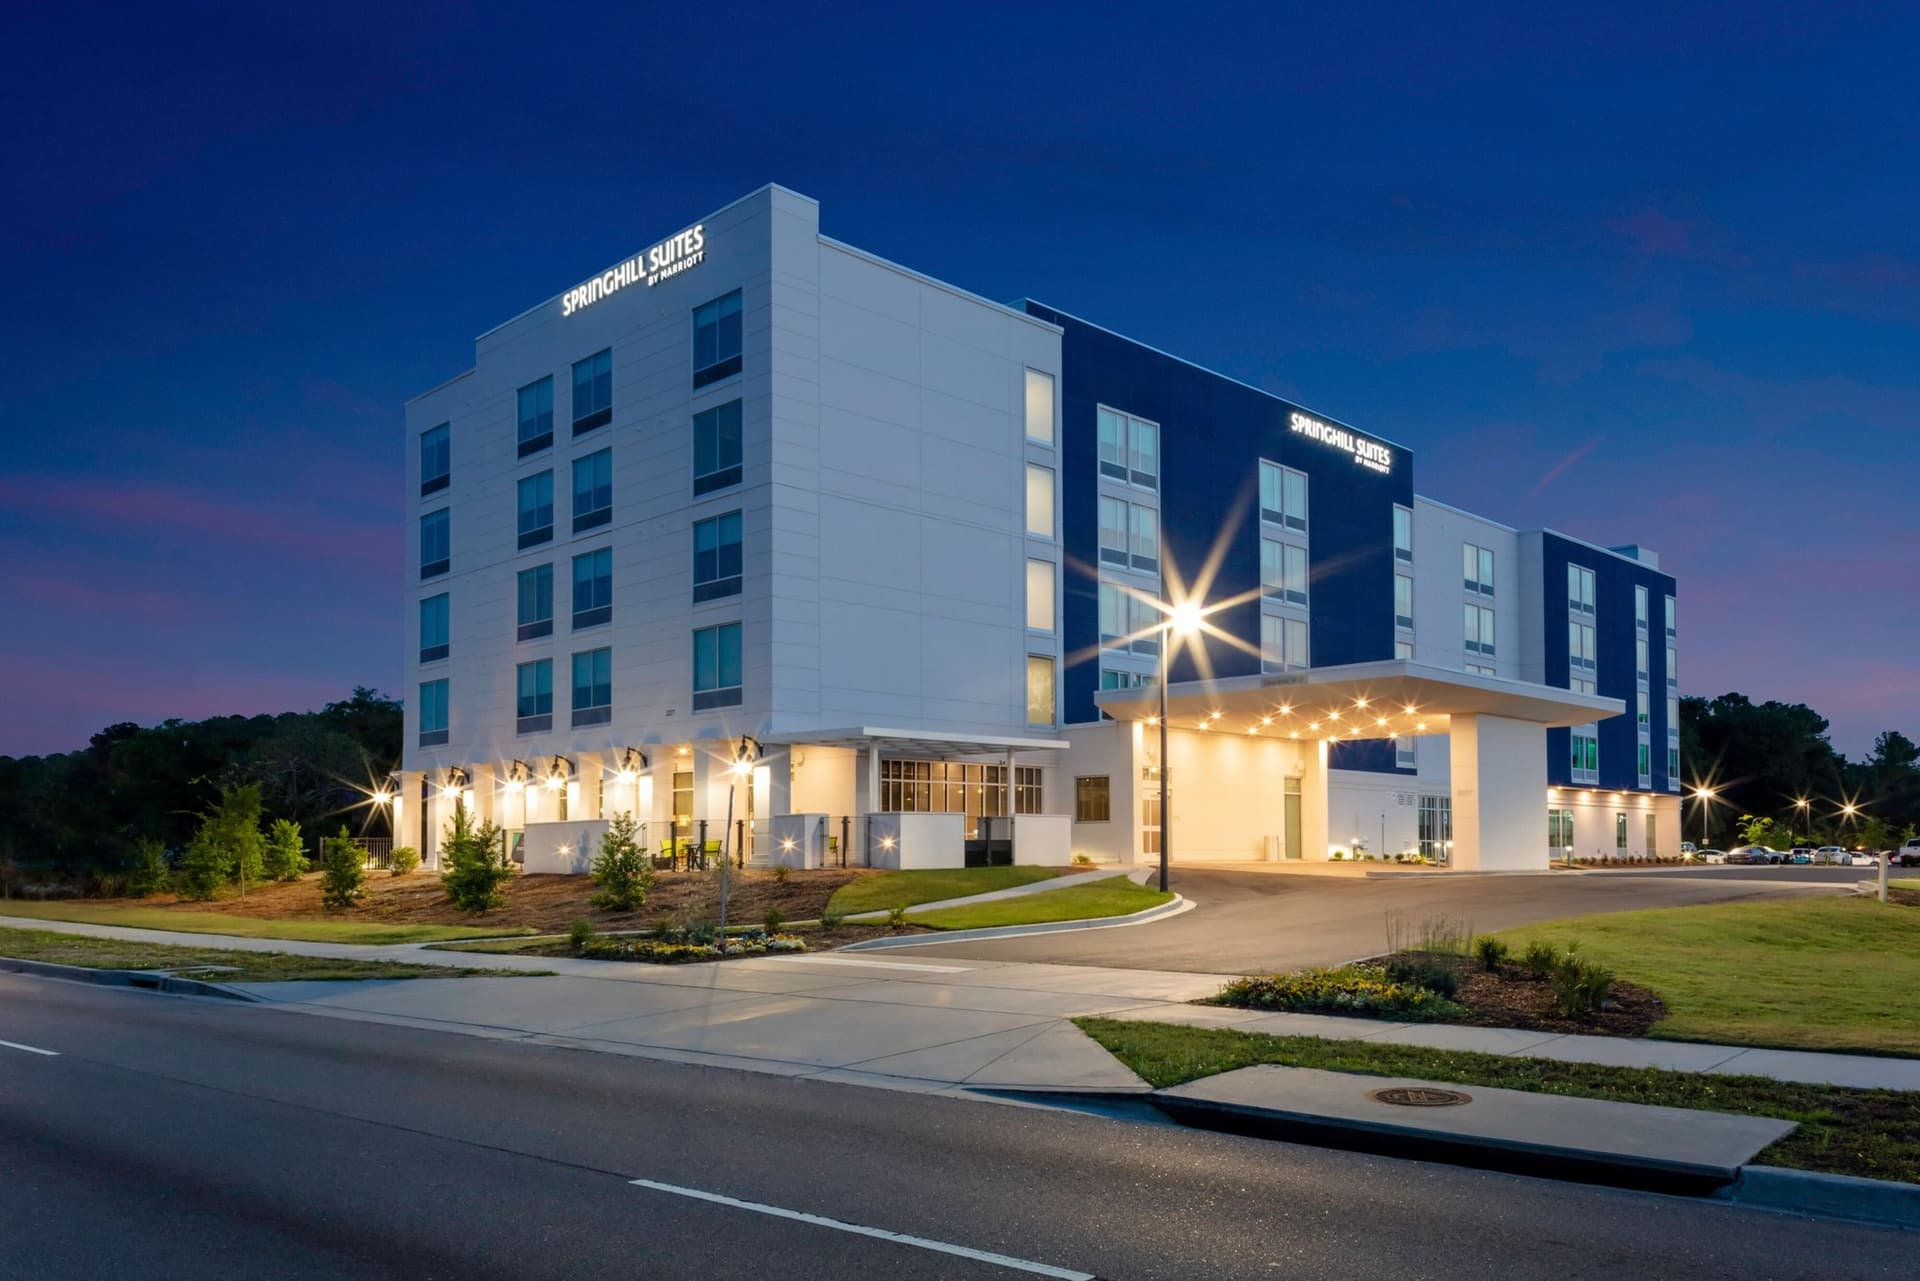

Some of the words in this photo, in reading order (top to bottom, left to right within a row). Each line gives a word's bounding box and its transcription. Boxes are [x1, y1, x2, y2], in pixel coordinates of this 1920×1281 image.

[562, 255, 647, 317] SPRINGHILL
[649, 224, 704, 273] SUITES
[647, 273, 660, 287] BY
[660, 250, 704, 281] MARRIOTT
[1291, 412, 1356, 453] SPRINGHILL
[1356, 438, 1391, 466] SUITES
